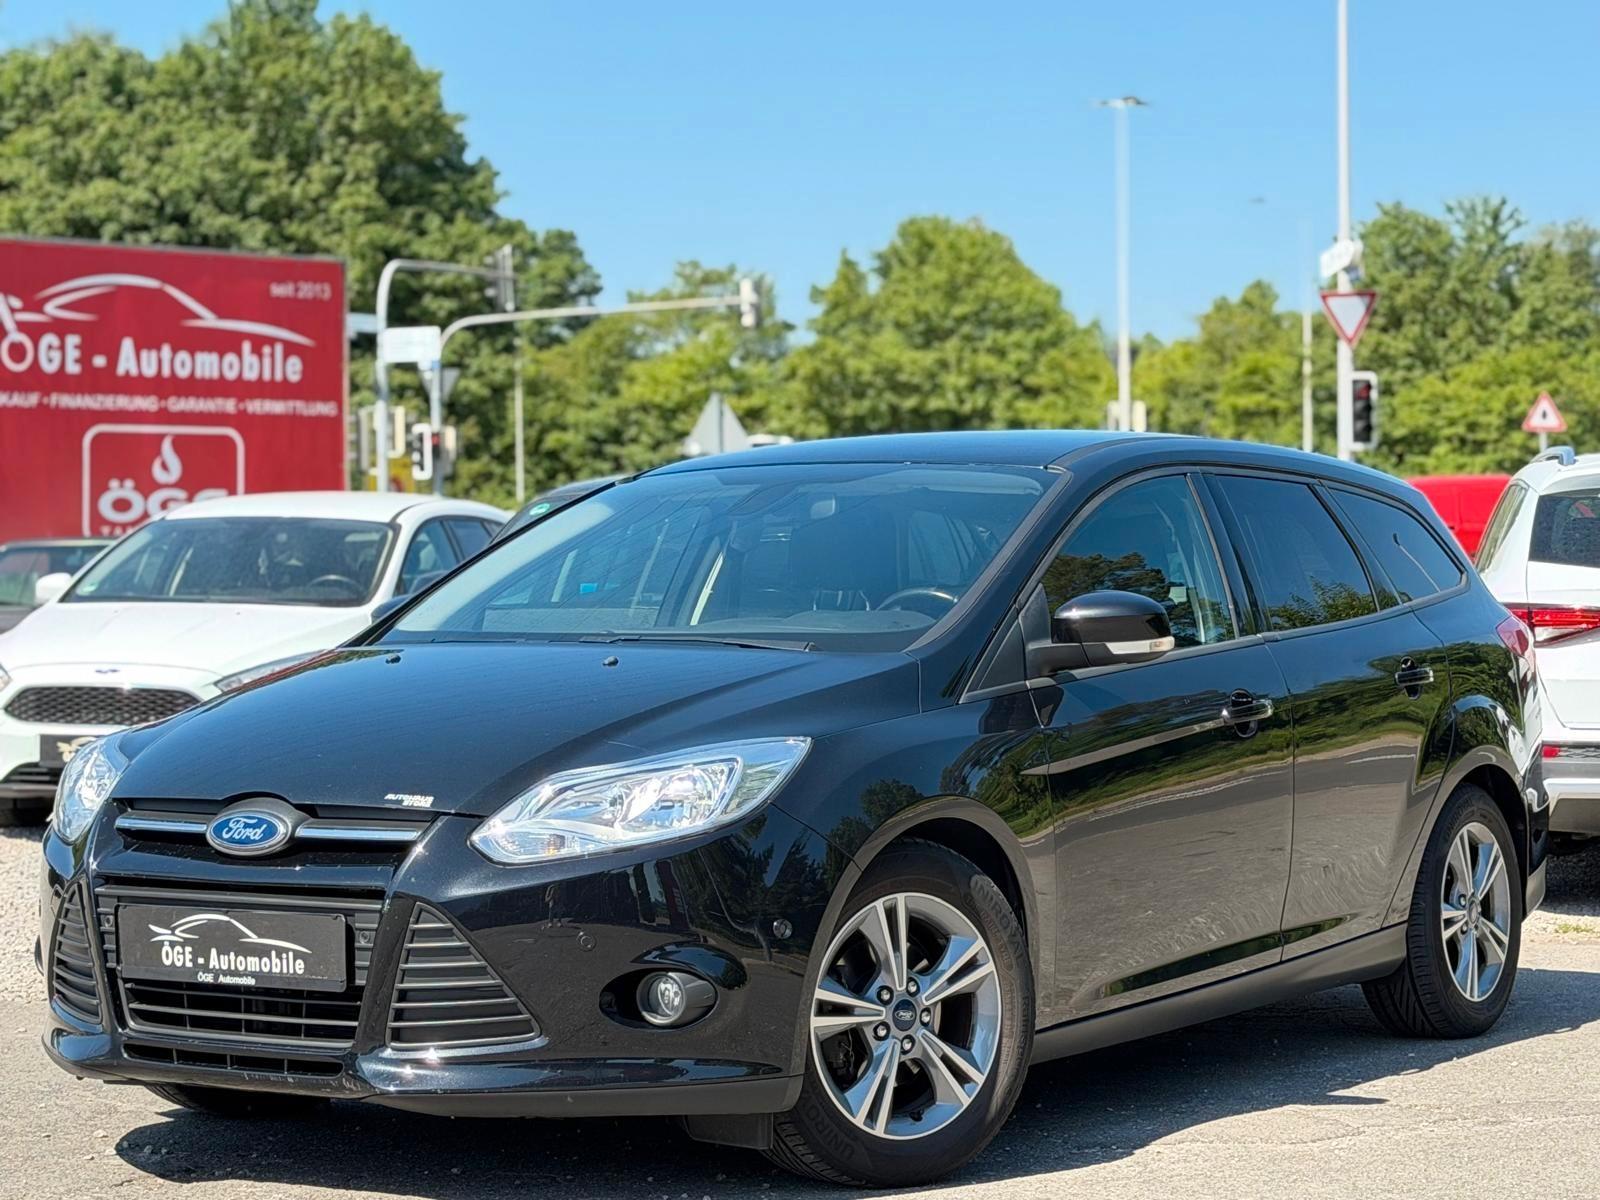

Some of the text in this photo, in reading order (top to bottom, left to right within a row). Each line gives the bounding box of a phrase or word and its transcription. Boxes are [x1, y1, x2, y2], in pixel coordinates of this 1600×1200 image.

[116, 336, 303, 383] Automobile
[222, 816, 268, 841] Ford
[161, 941, 193, 968] ÖGE
[208, 947, 306, 975] Automobile
[197, 971, 256, 986] ÖGE Automobile
